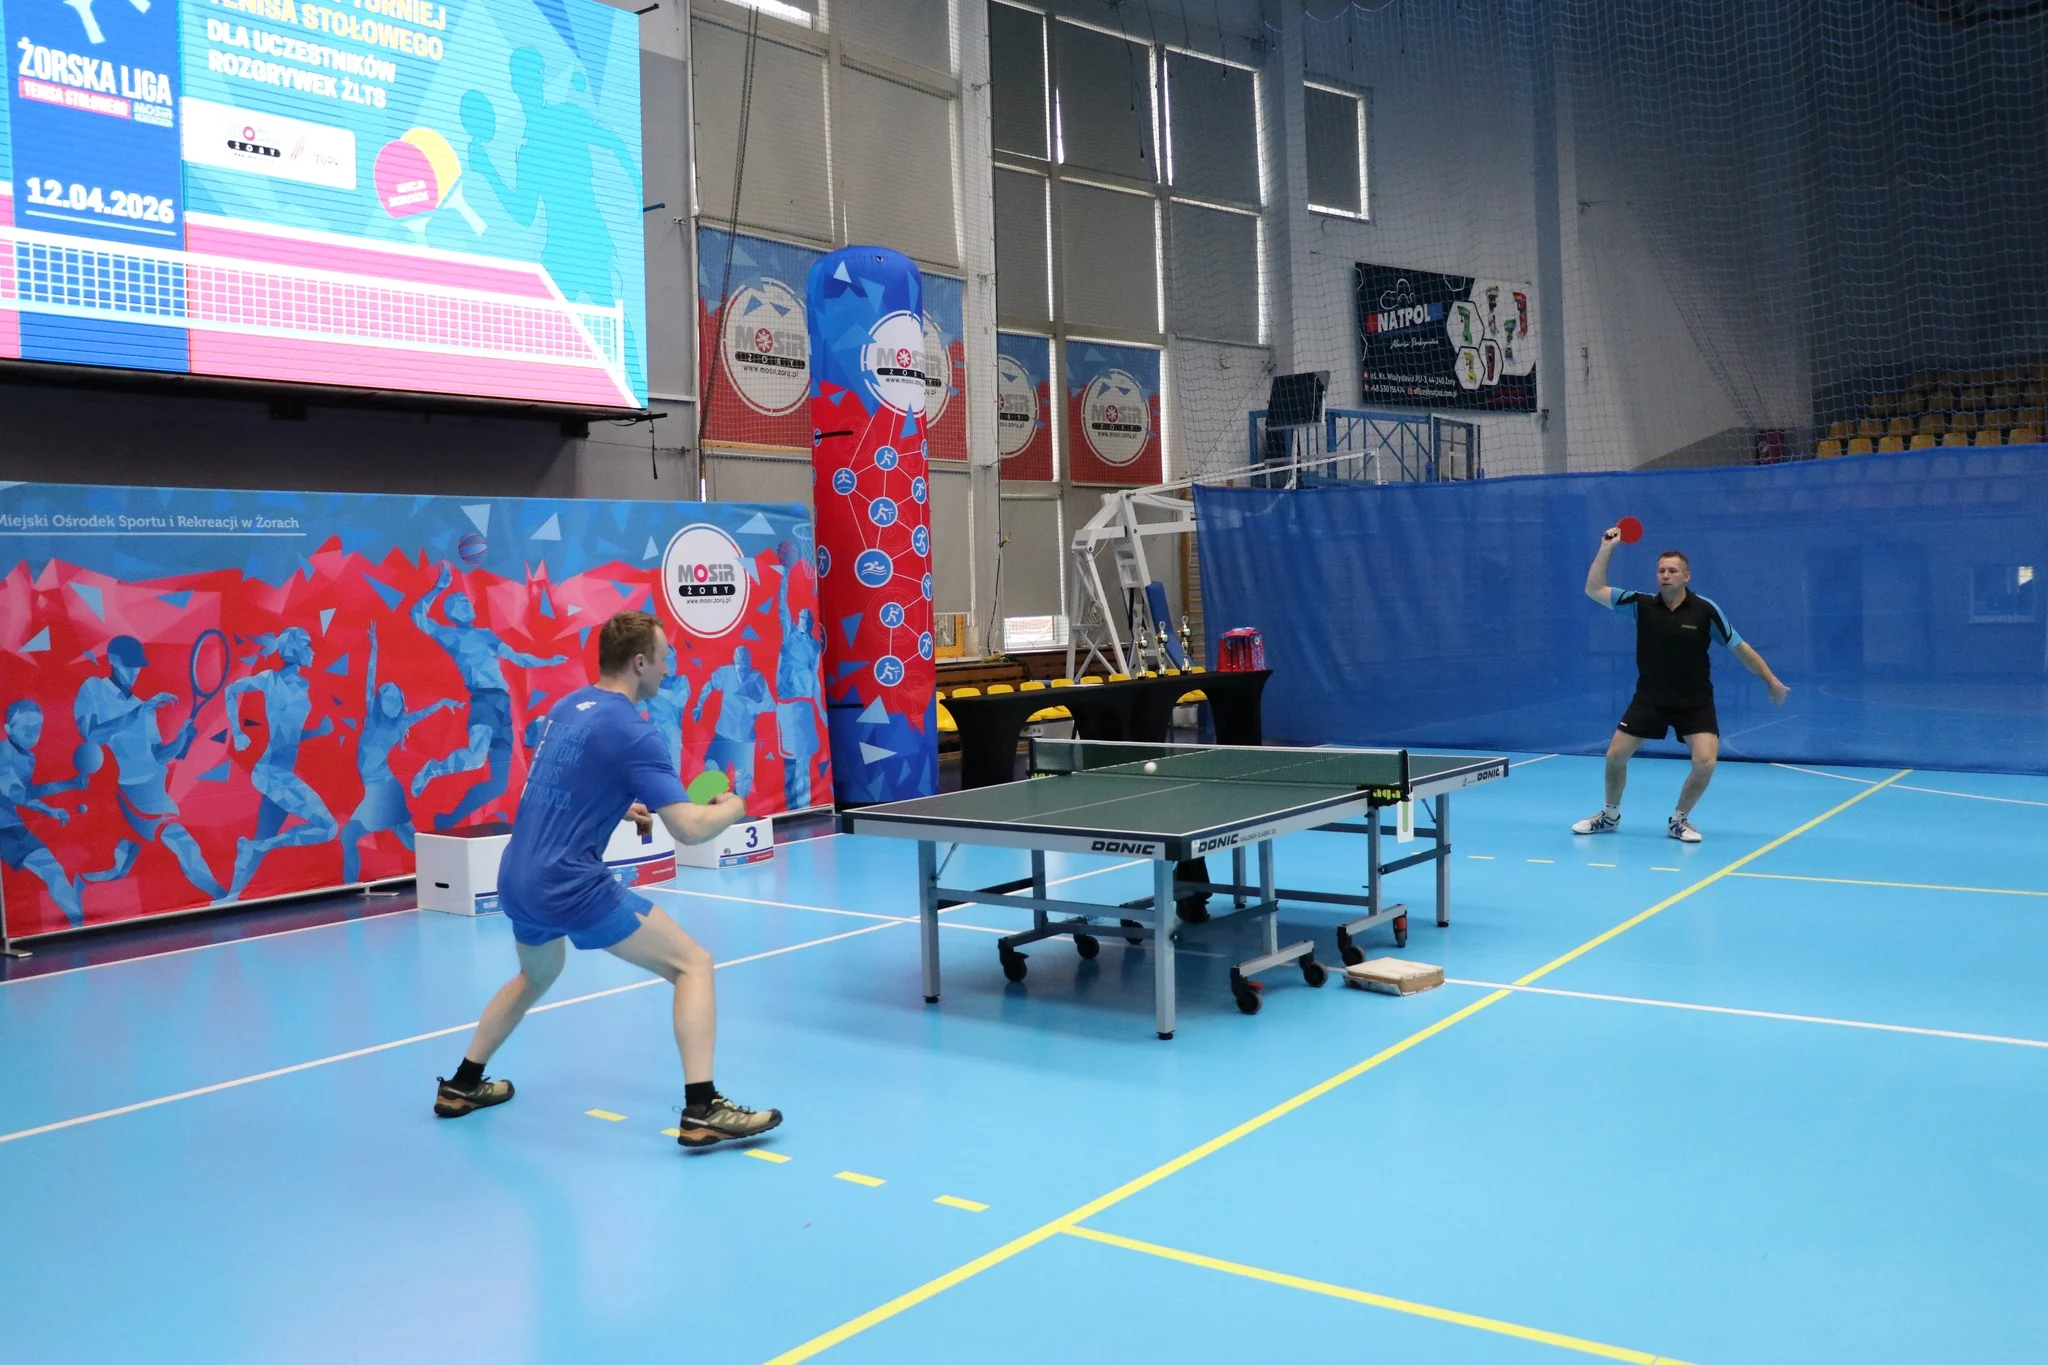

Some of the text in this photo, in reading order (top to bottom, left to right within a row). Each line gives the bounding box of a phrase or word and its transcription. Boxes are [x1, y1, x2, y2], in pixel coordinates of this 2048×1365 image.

[302, 3, 444, 60] STOŁOWEGO
[207, 18, 396, 82] DLA UCZESTNIKÓW
[17, 36, 173, 106] ŻORSKA LIGA
[208, 49, 387, 109] ROZGRYWEK ŻLTS
[26, 177, 175, 224] 12.04.2026
[1377, 303, 1431, 333] NATPOL
[743, 365, 799, 378] www.mosir.zory.pl
[52, 514, 115, 528] Ośrodek
[119, 514, 166, 530] Sportu
[169, 515, 174, 528] i
[178, 515, 238, 531] Rekreacji
[242, 519, 252, 528] w
[255, 515, 300, 529] Żorach
[686, 597, 732, 605] www.mosir.zory.pl
[1477, 768, 1500, 782] DONIC
[745, 826, 758, 848] 3
[1091, 840, 1156, 855] DONIC
[1198, 833, 1239, 853] DONIC
